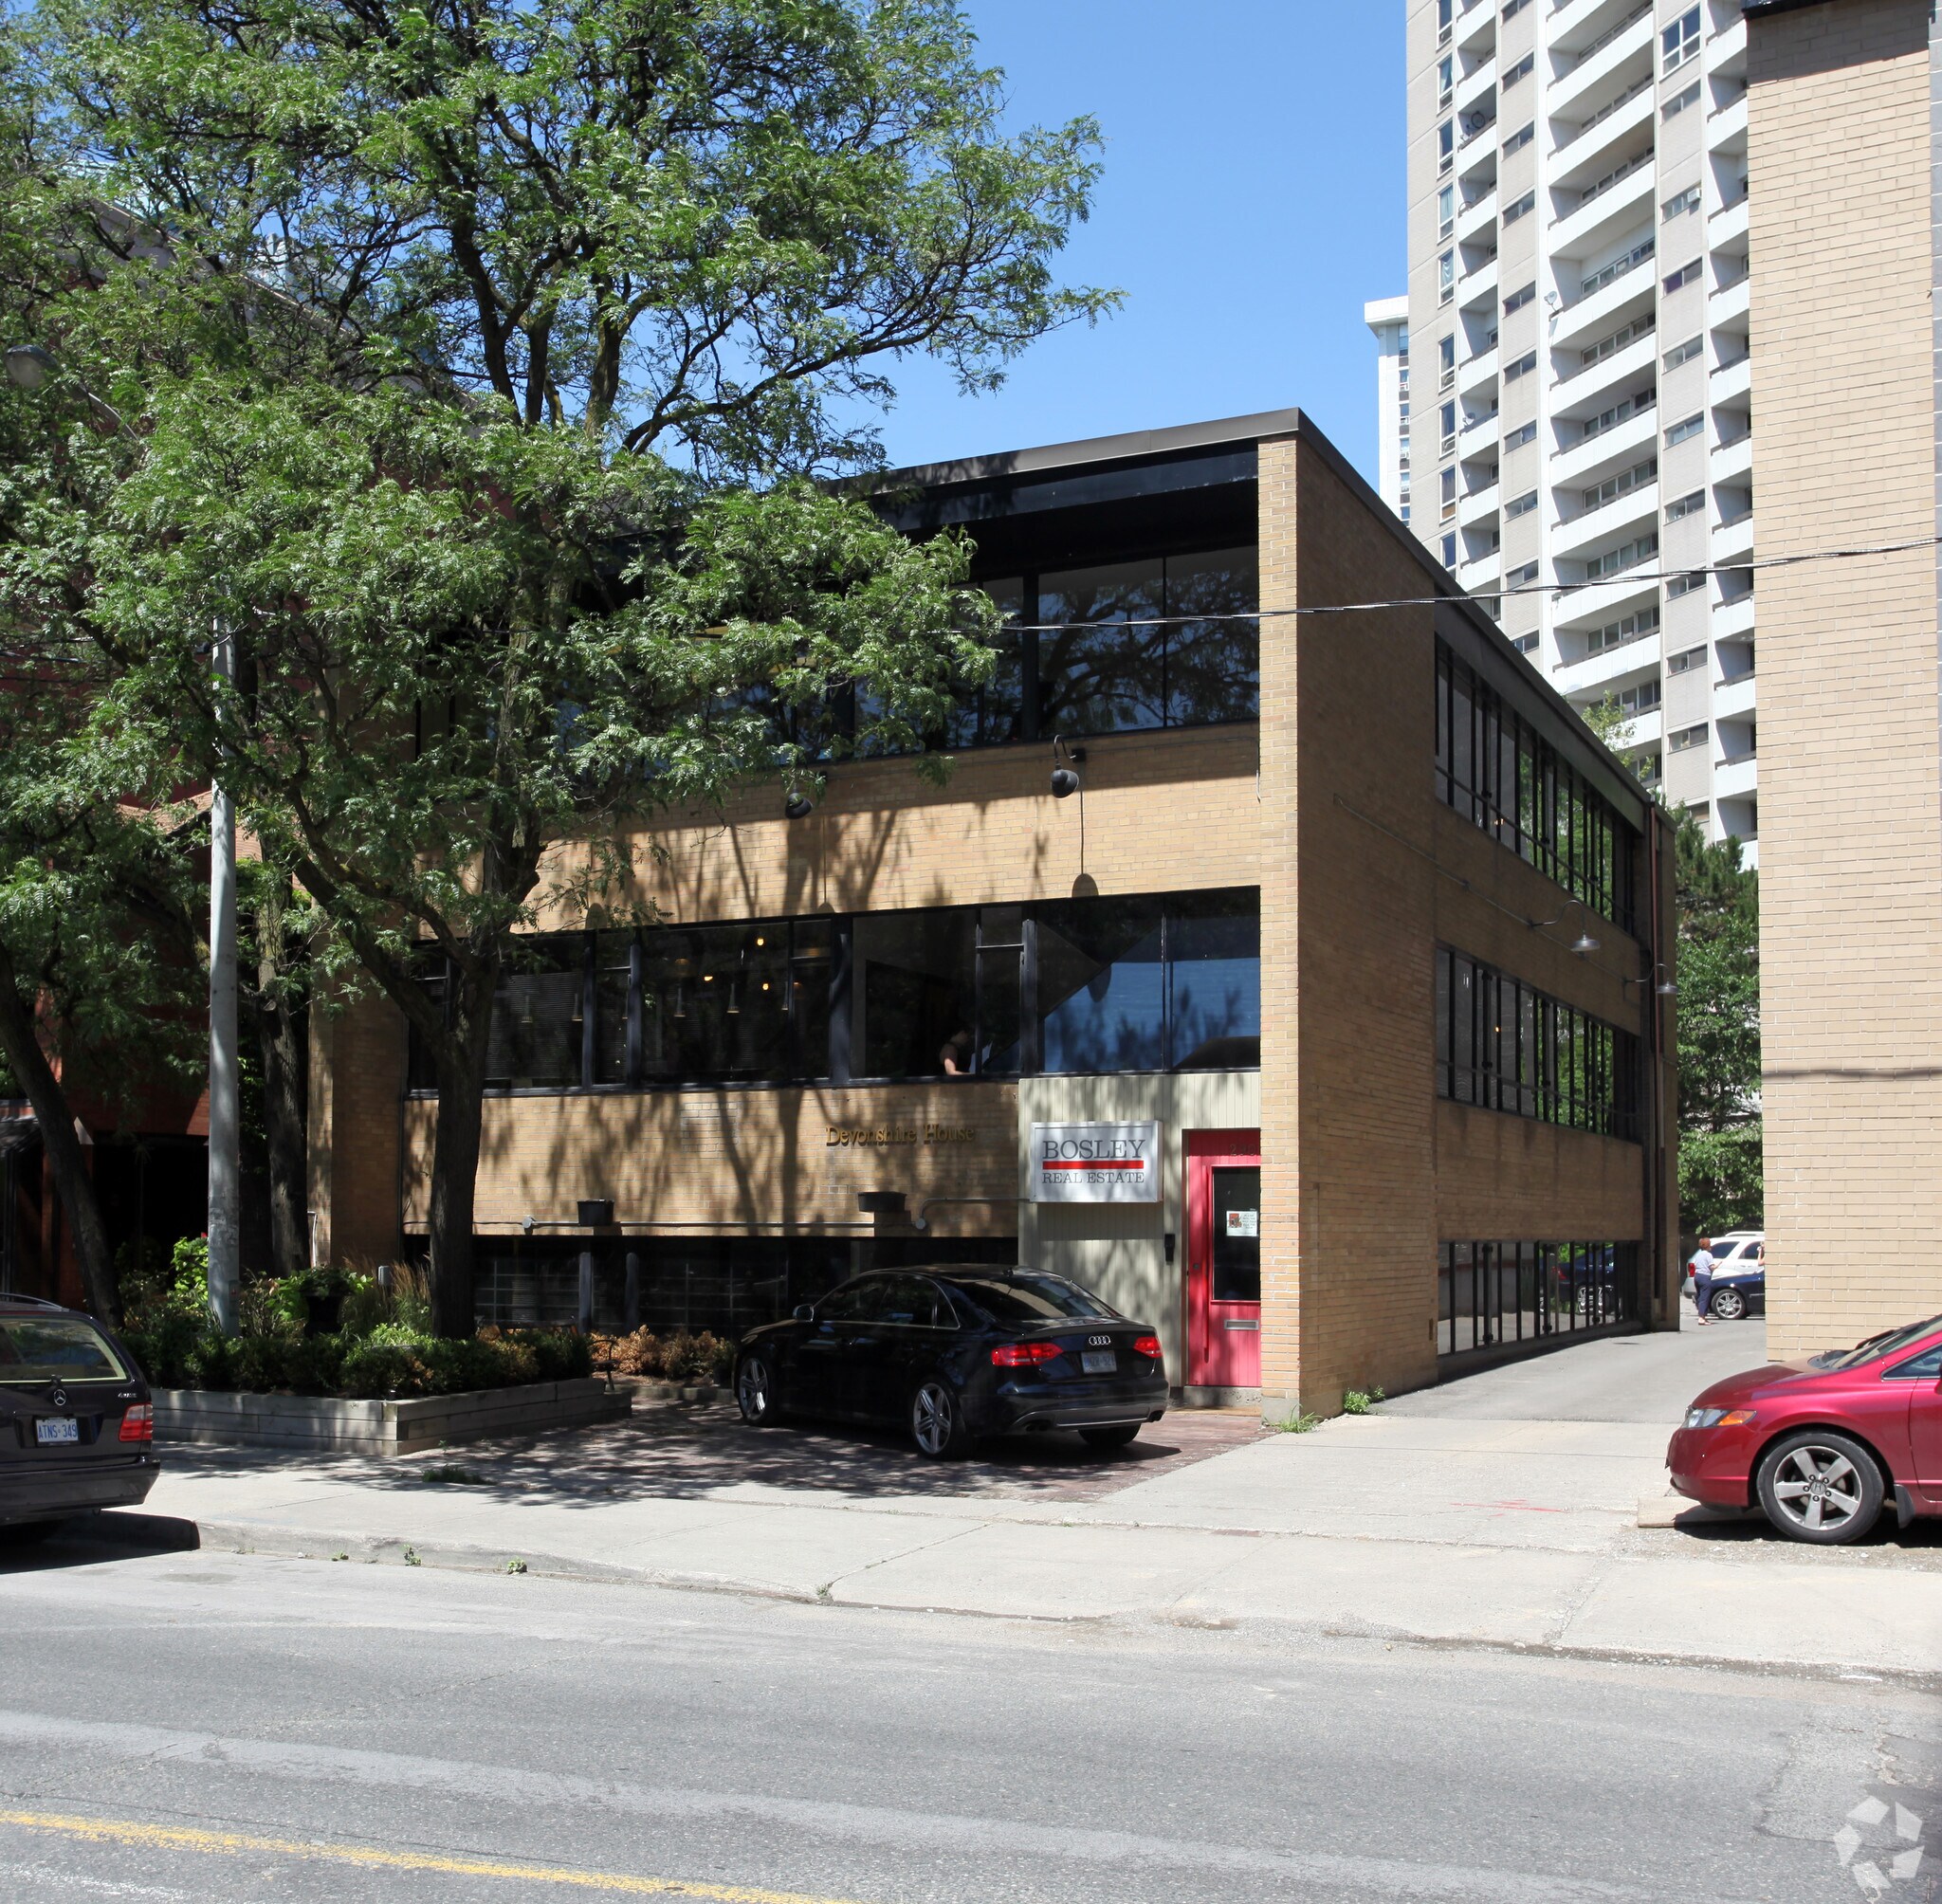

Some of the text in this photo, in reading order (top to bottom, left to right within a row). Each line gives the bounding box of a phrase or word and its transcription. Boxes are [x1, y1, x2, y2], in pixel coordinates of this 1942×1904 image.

[825, 1124, 975, 1145] Devonshire House
[1042, 1139, 1145, 1159] BOSLEY
[1042, 1172, 1145, 1184] REAL ESTATE
